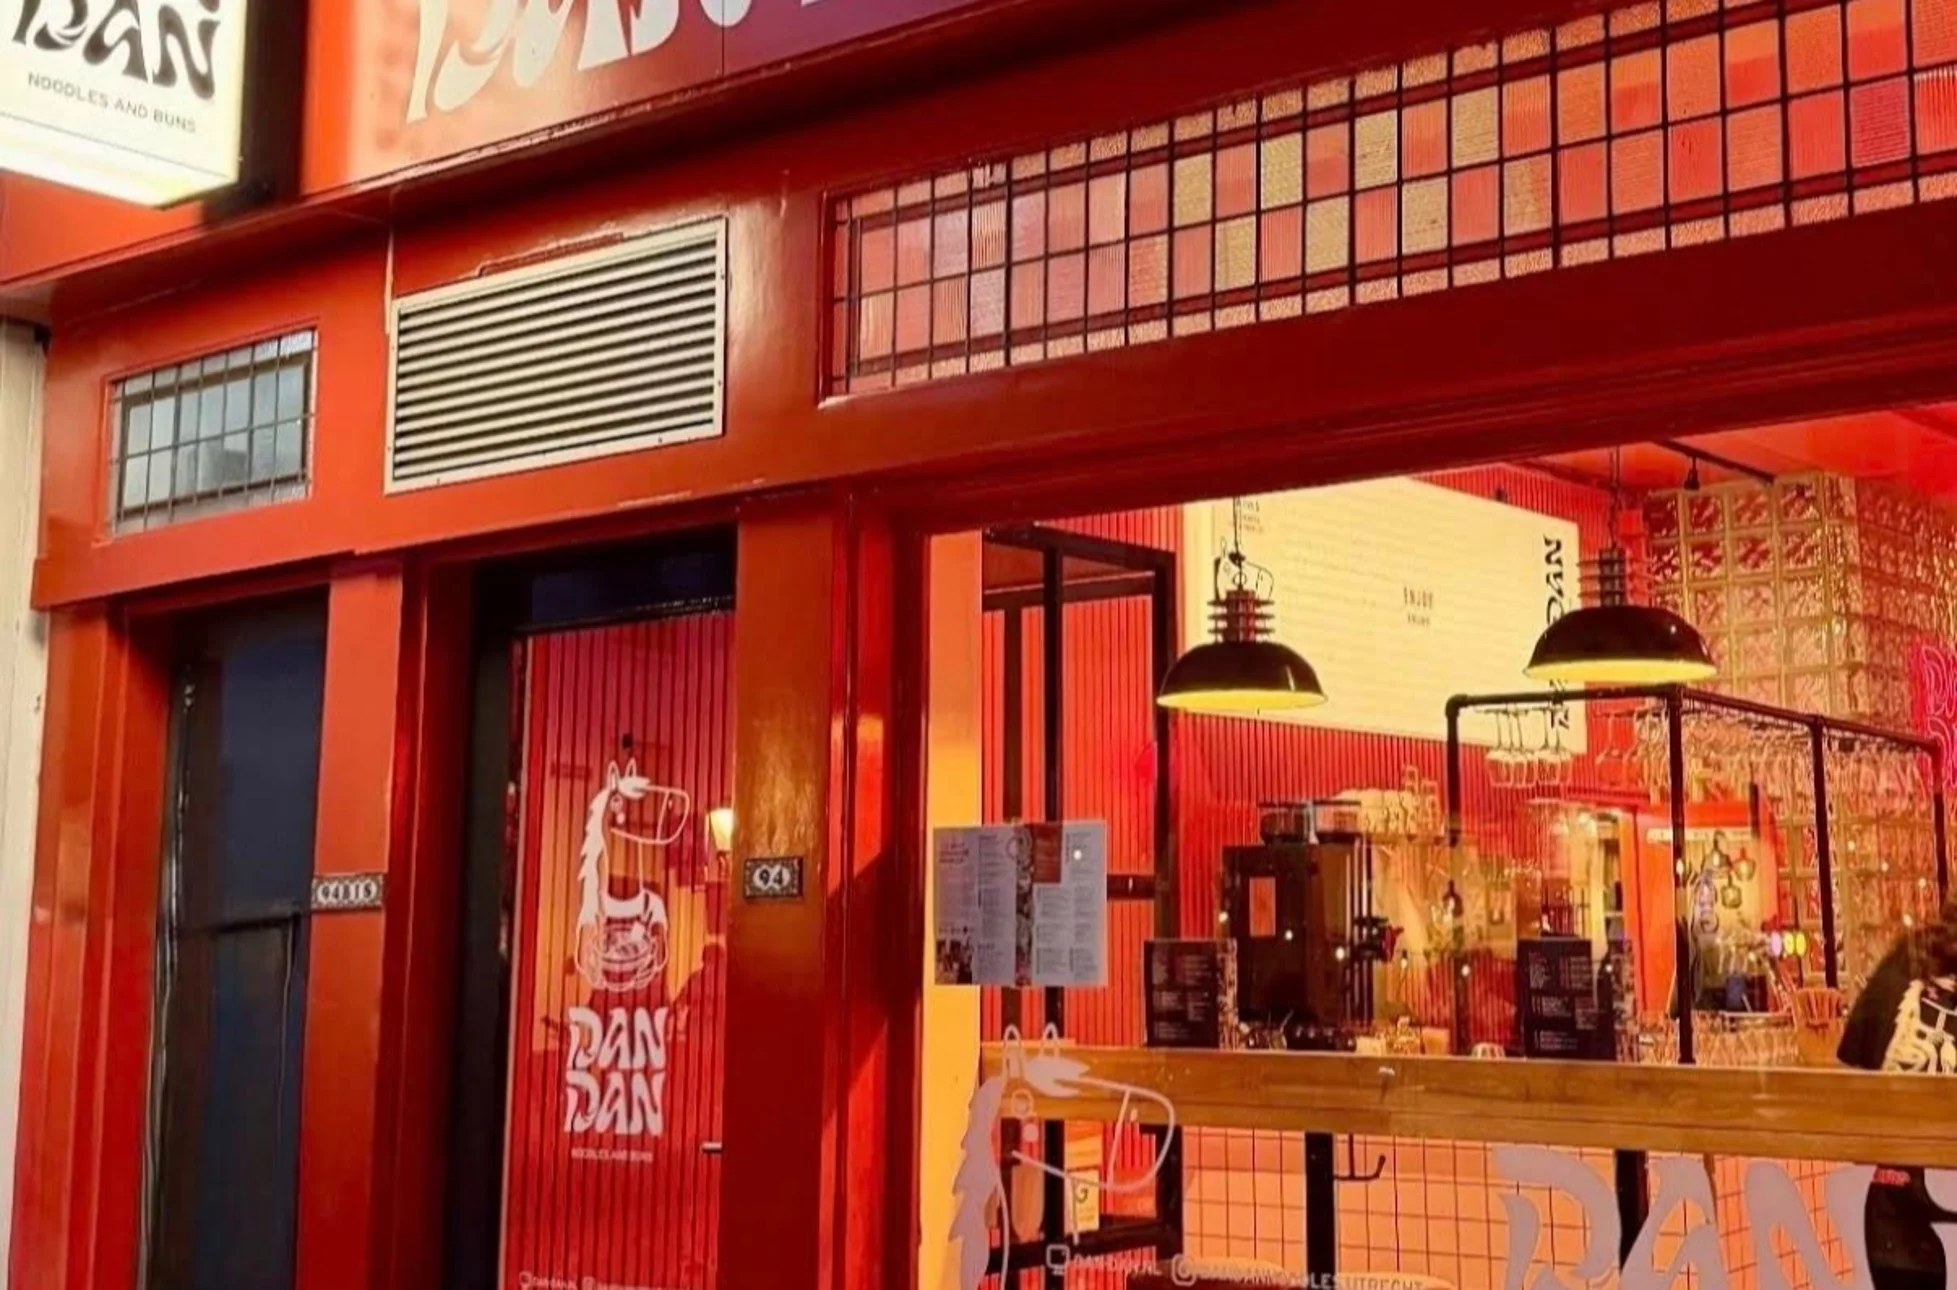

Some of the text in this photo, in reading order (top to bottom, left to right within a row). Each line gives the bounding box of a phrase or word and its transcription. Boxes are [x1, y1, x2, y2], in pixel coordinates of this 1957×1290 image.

[28, 71, 197, 134] NOODLES AND BUNS
[755, 865, 788, 889] 94
[567, 1007, 669, 1069] DAN
[564, 1071, 666, 1136] DAN
[1491, 1143, 1876, 1290] DAN
